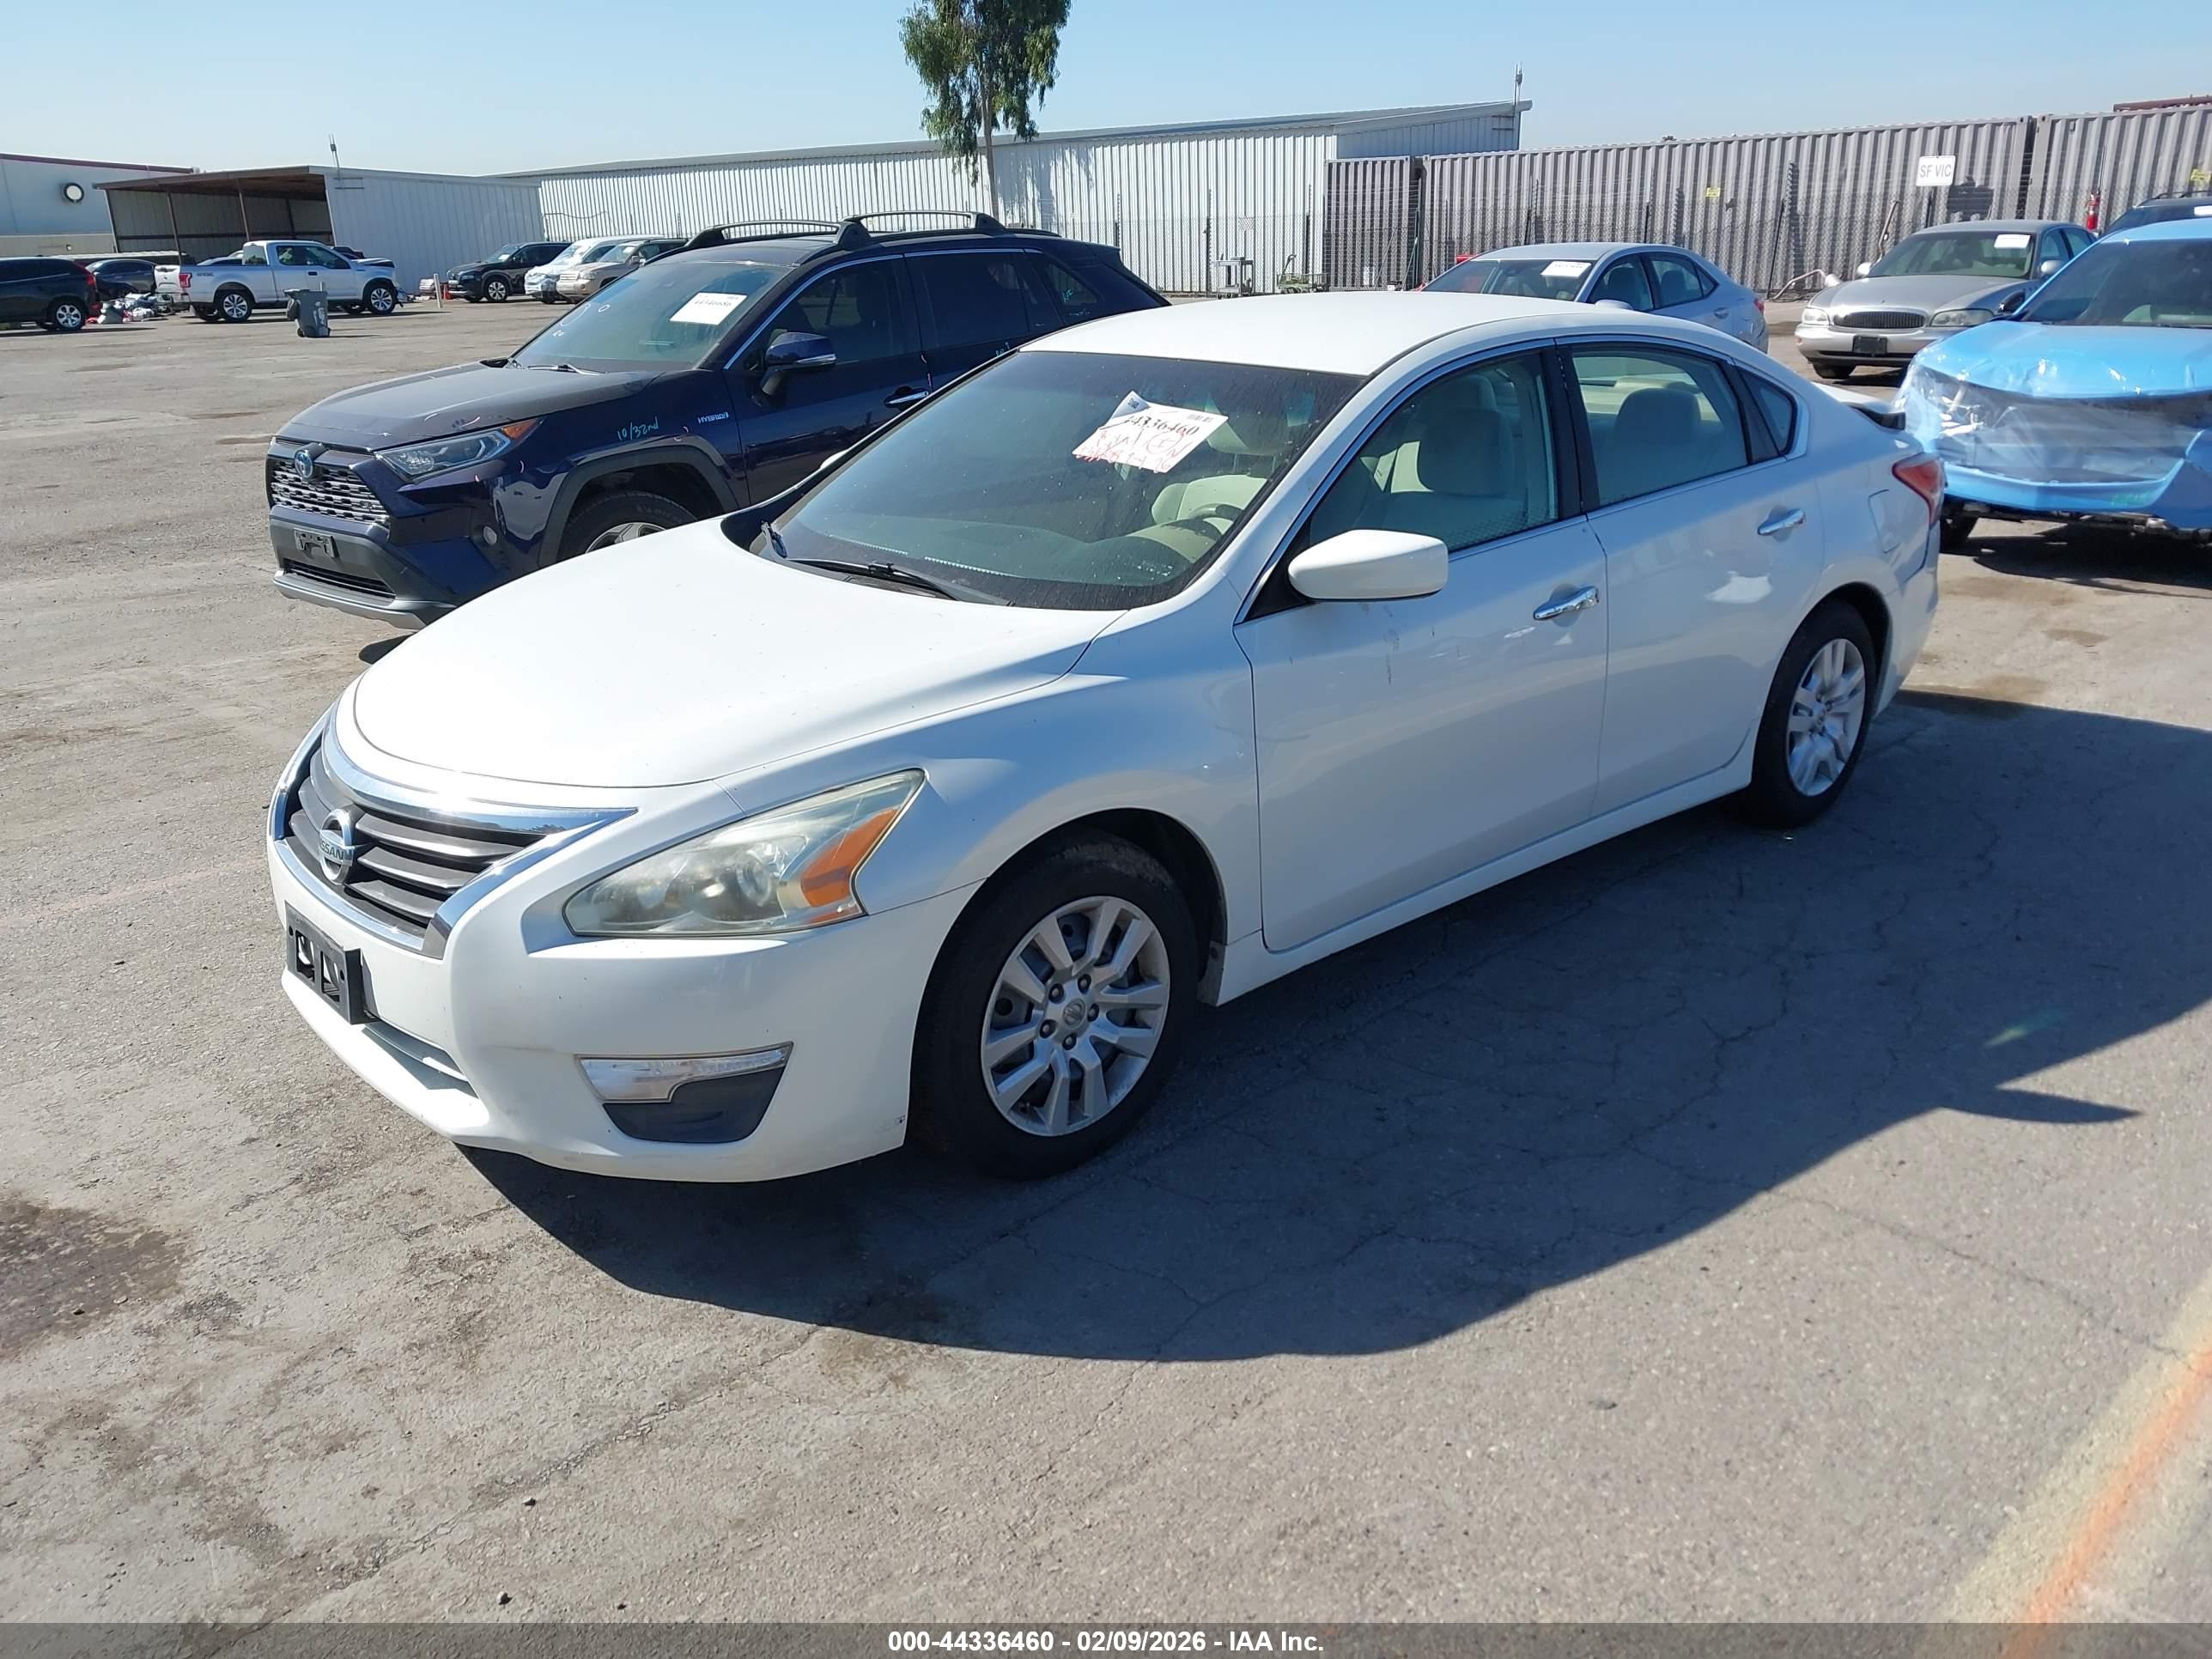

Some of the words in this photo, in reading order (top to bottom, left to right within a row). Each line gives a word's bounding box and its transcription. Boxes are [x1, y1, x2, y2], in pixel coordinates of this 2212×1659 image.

[1920, 164, 1932, 178] SF
[1936, 164, 1951, 178] VIC
[697, 412, 728, 423] HYBRID
[319, 838, 344, 860] SSAN
